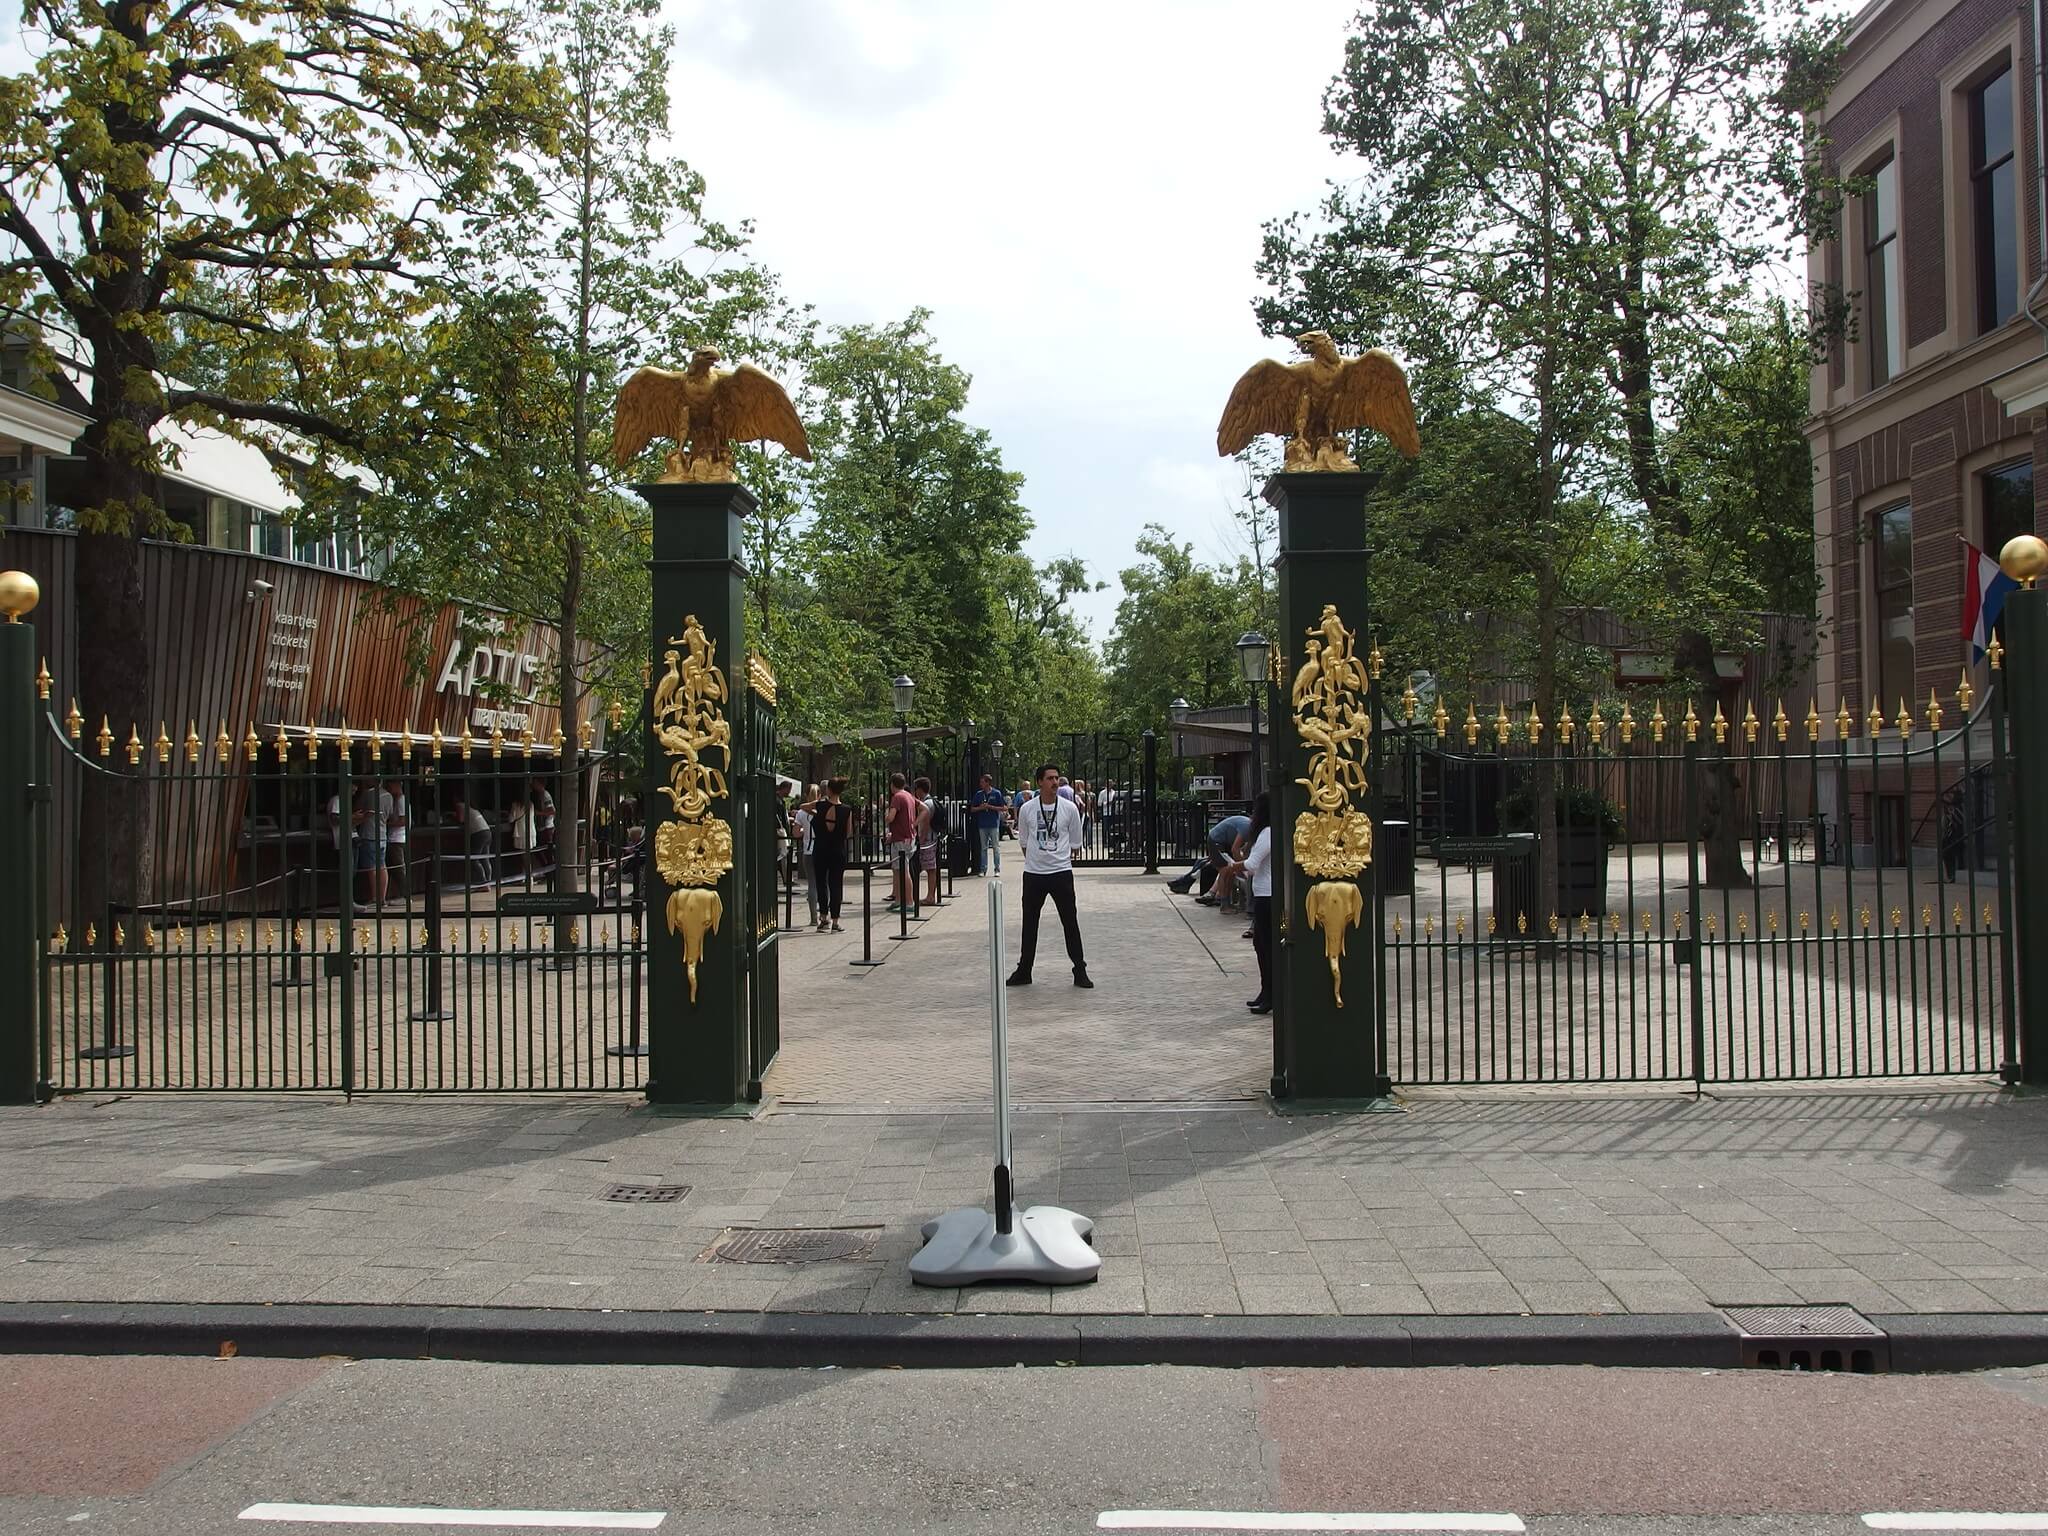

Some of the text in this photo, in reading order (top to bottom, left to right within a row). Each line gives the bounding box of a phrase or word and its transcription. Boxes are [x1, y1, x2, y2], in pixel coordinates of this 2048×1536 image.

[275, 610, 318, 630] kaartjes
[272, 633, 310, 649] tickets
[268, 660, 312, 675] Artis-park
[436, 639, 543, 705] ARTIS
[266, 677, 303, 692] Micropia
